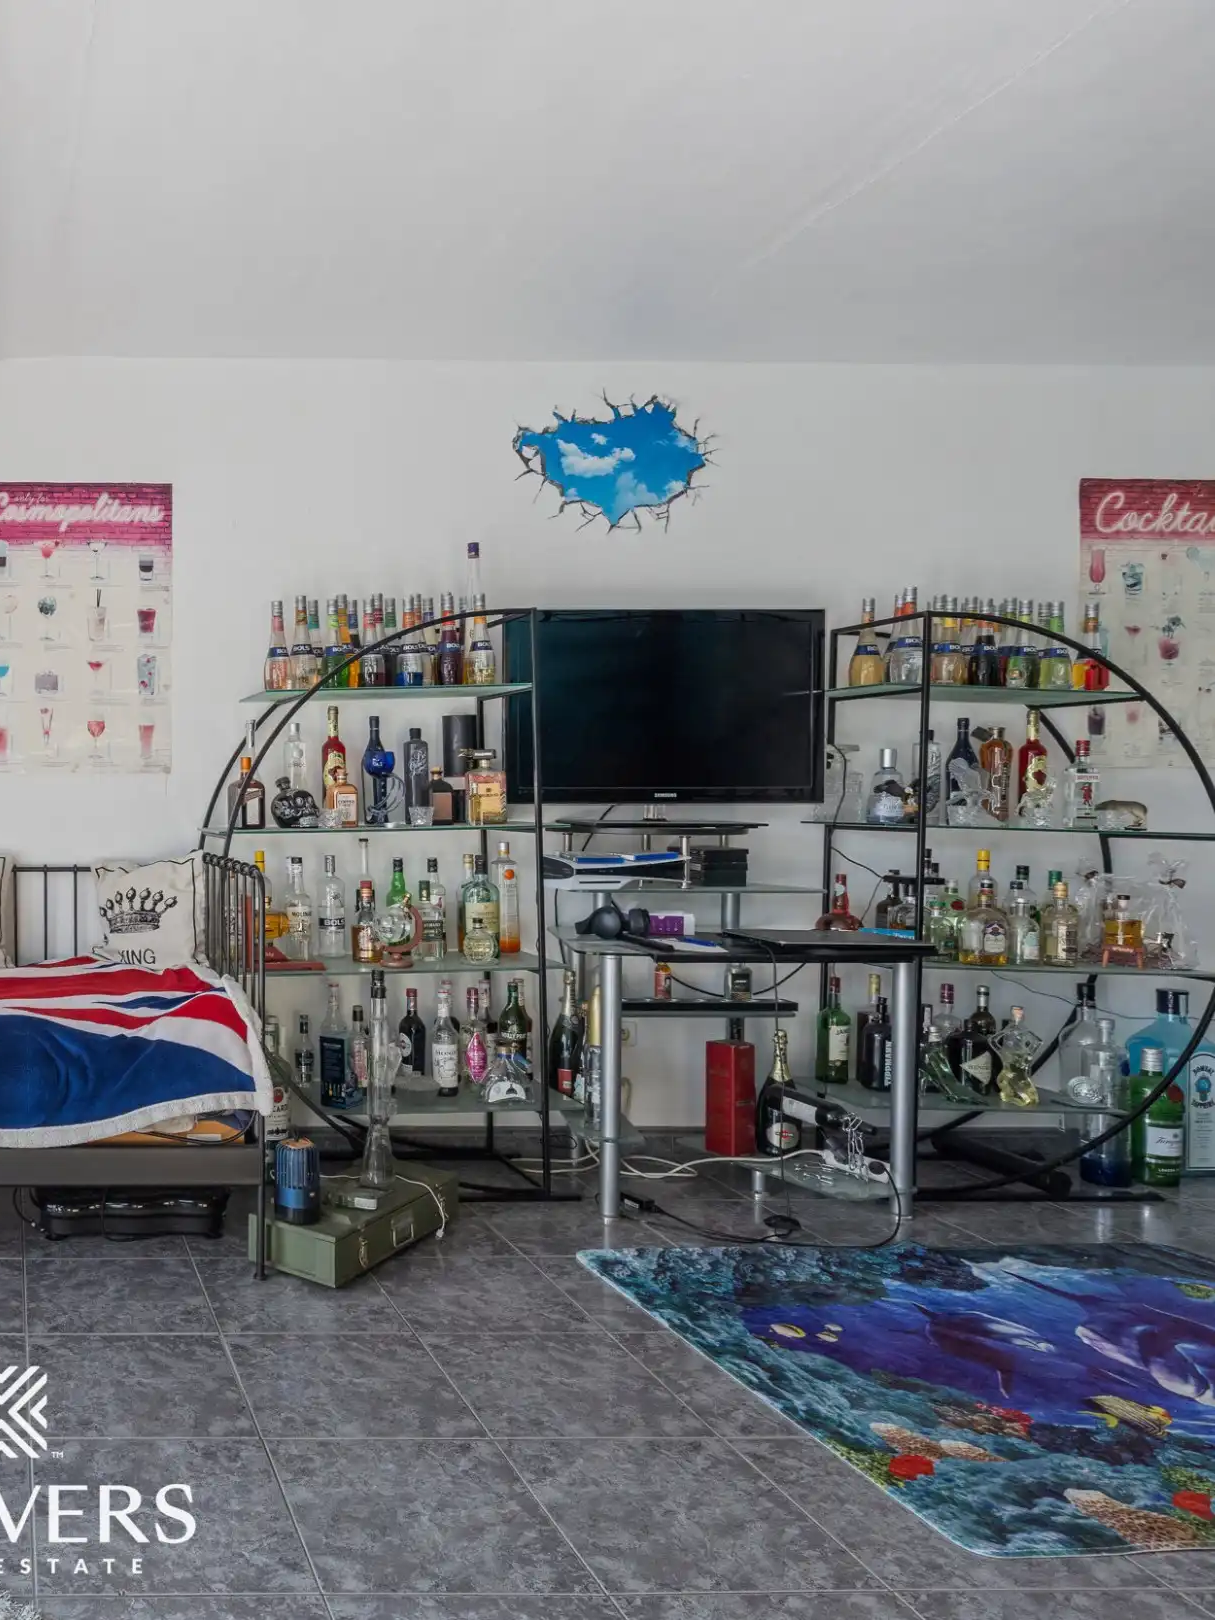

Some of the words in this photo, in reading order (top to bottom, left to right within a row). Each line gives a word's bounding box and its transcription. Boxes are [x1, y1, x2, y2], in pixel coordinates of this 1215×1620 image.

[1095, 491, 1215, 534] Cockta
[324, 917, 345, 926] BOLS
[884, 1039, 893, 1087] TIPPMANN
